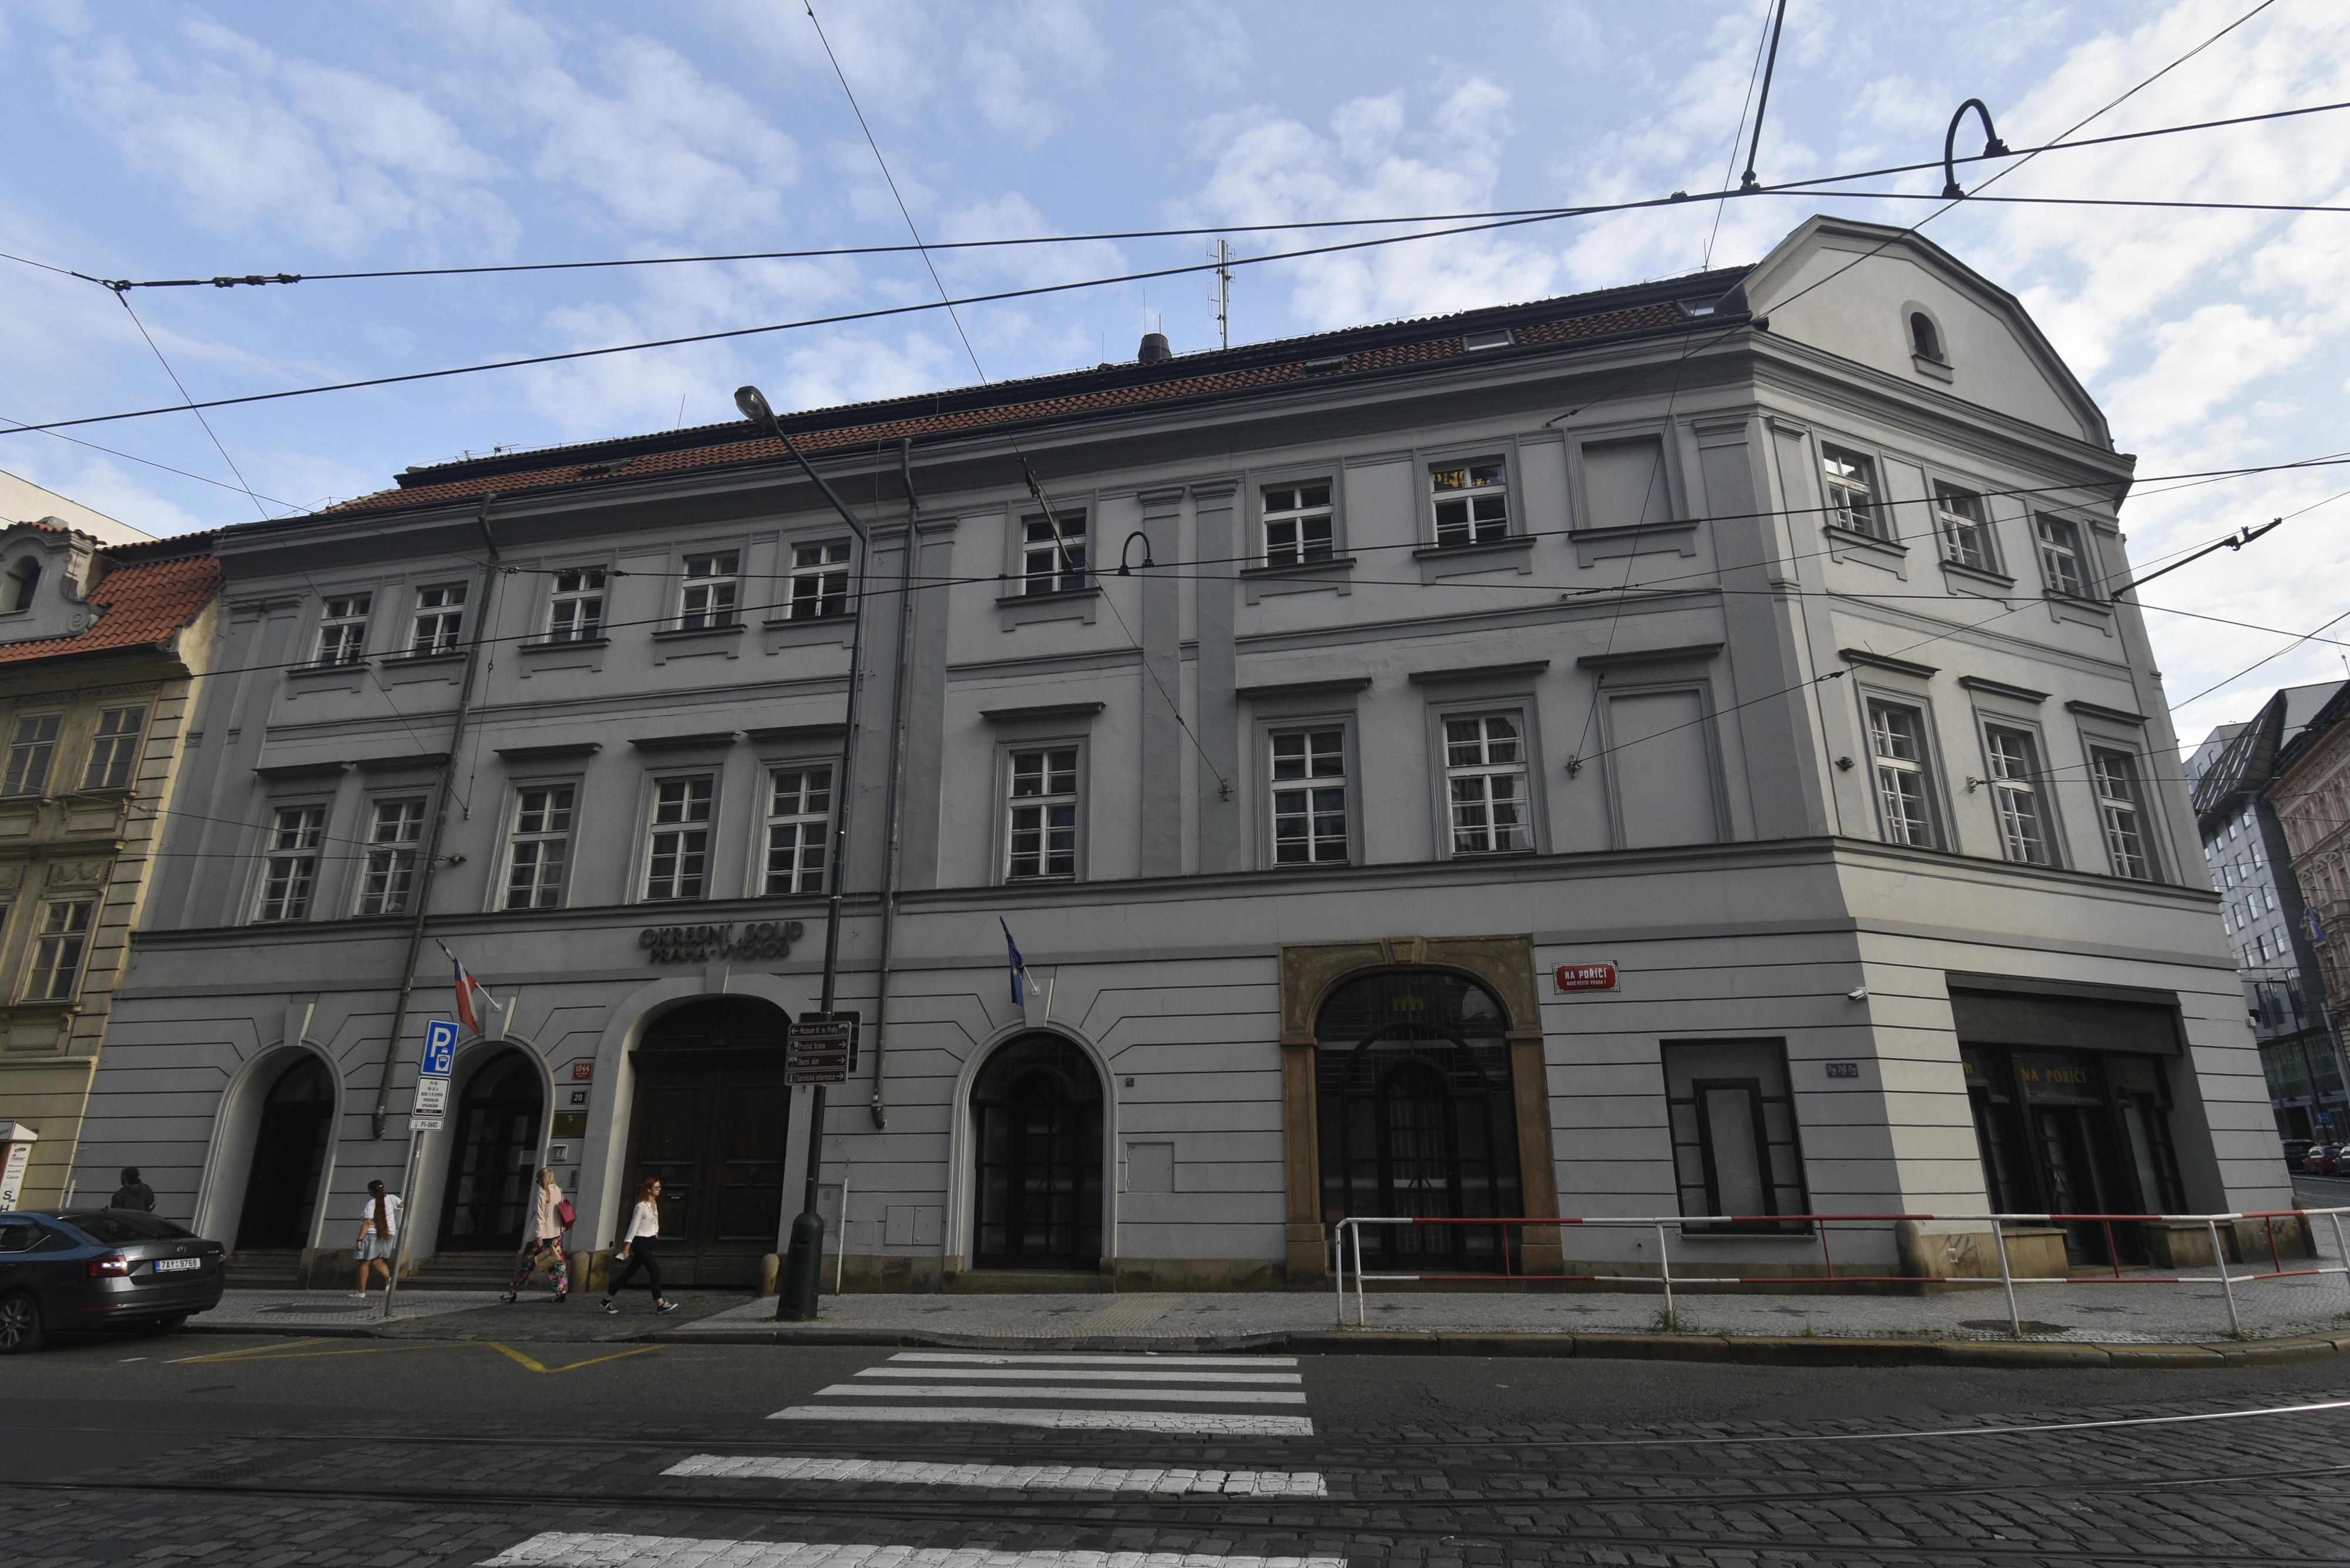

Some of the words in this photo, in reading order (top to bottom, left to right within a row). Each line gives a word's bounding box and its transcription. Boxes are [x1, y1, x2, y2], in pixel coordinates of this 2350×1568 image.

[639, 921, 733, 946] OKRESNÍ
[744, 922, 805, 942] SOUD
[1565, 971, 1575, 979] NA
[1579, 968, 1607, 979] POŘÍČÍ
[430, 1027, 451, 1057] P
[2021, 1069, 2039, 1082] NA
[2046, 1067, 2087, 1083] POŘÍČÍ
[162, 1261, 176, 1269] 7AY
